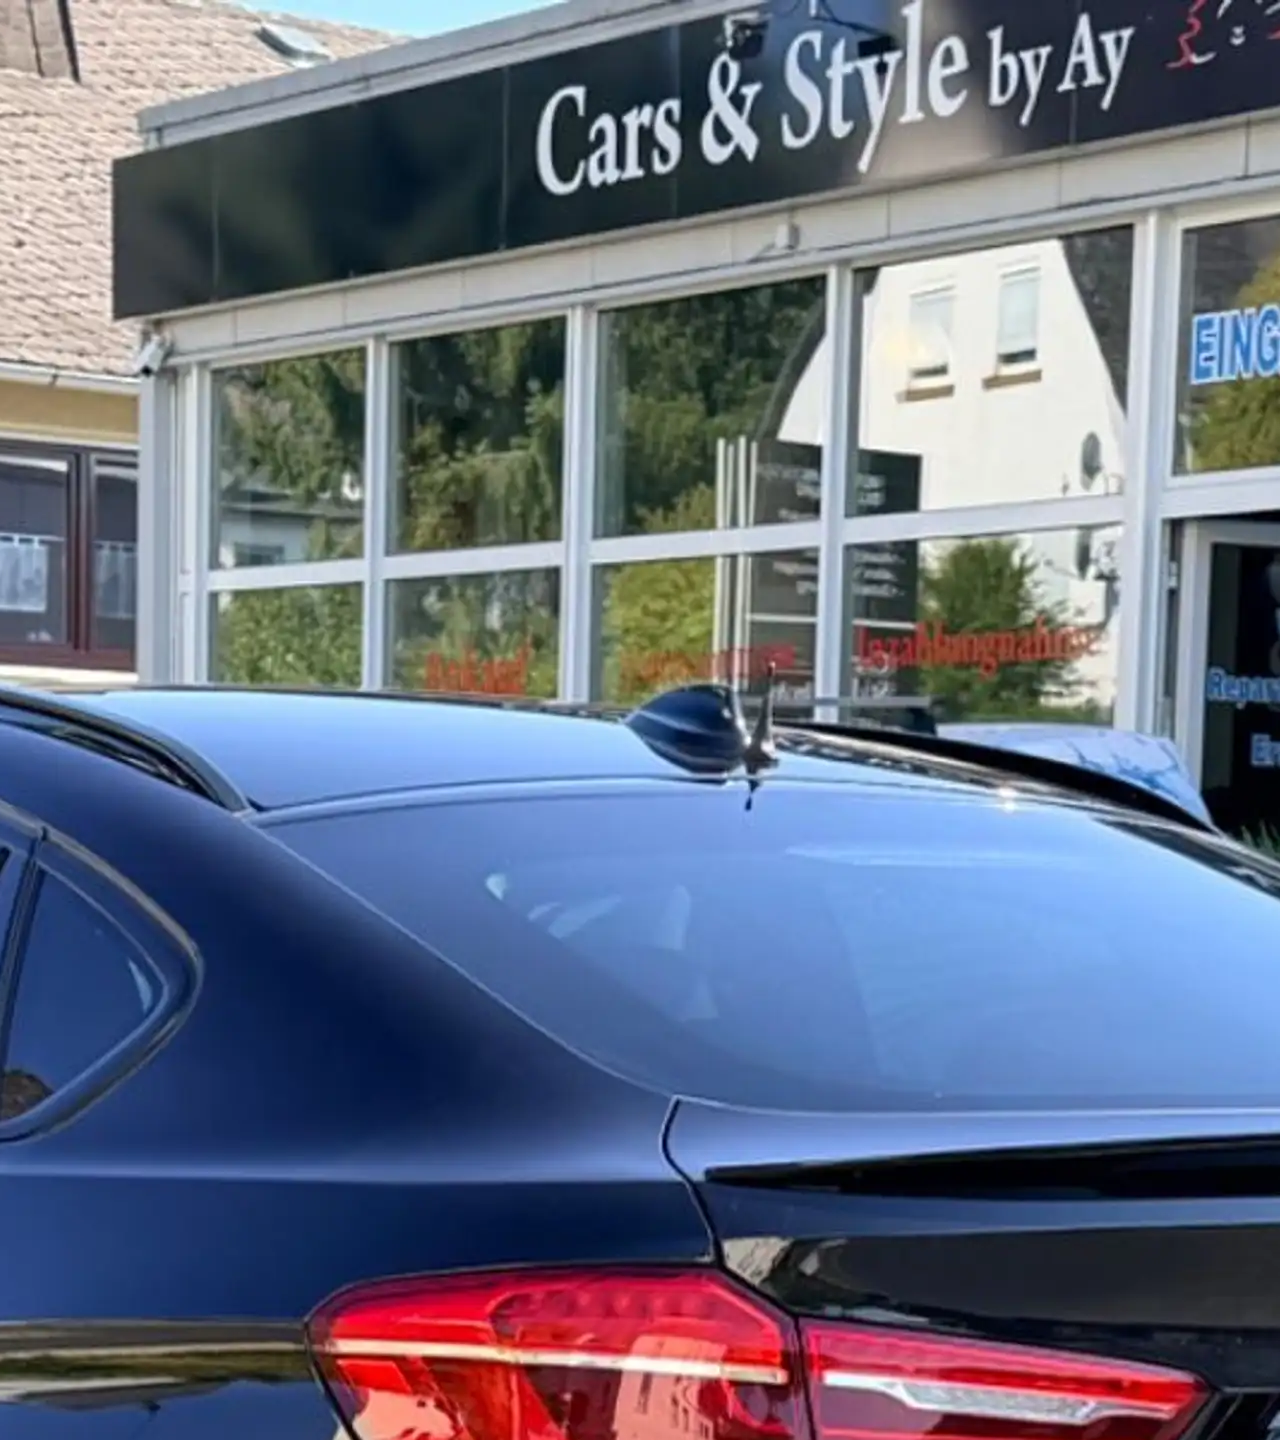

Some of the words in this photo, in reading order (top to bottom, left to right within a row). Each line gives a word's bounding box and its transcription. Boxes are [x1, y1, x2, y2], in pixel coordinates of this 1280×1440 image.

[536, 86, 681, 196] Cars
[701, 53, 760, 163] &
[782, 4, 970, 174] Style
[988, 26, 1051, 126] by
[1057, 13, 1134, 111] Ay
